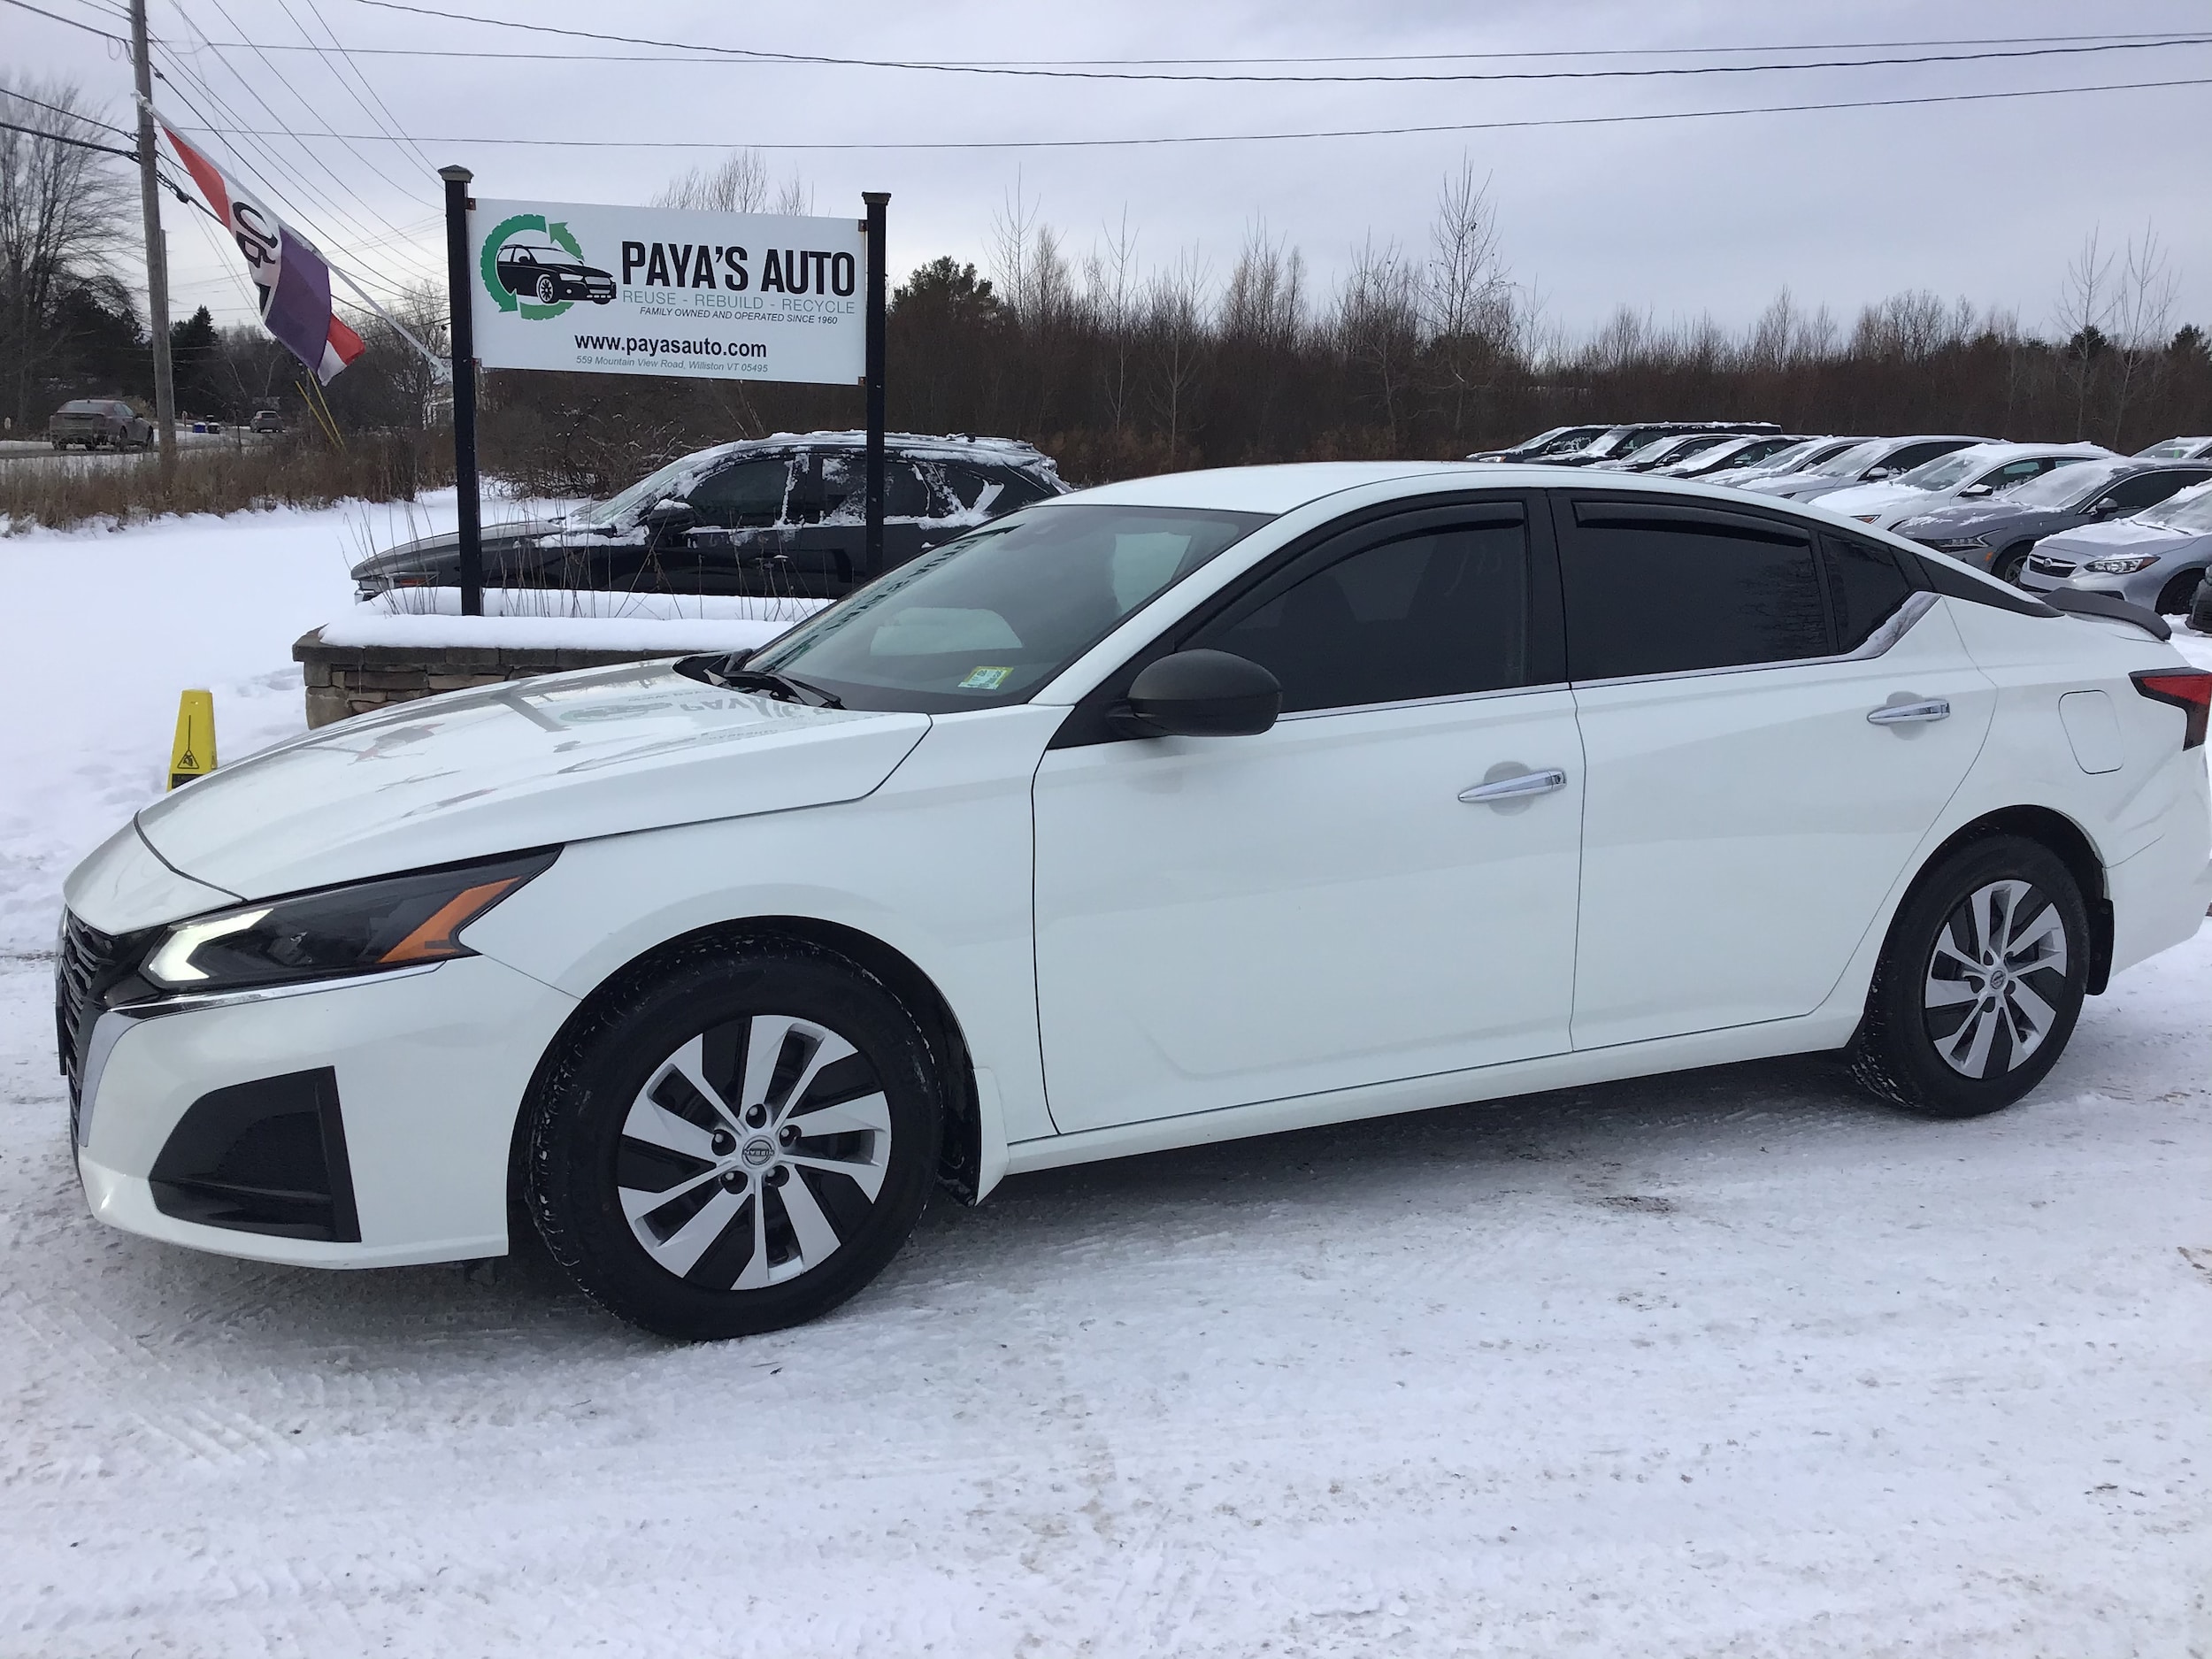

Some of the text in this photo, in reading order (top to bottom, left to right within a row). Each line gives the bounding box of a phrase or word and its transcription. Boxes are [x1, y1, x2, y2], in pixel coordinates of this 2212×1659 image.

[622, 241, 855, 296] PAYA'S AUTO
[622, 290, 676, 305] REUSE
[695, 294, 764, 310] REBUILD
[782, 298, 855, 314] RECYCLE
[640, 307, 838, 325] FAMILY OWNED AND OPERATED SINCE 1960
[574, 334, 767, 357] www.payasauto.com
[576, 355, 593, 365] 559
[595, 357, 635, 366] Mountain
[638, 358, 658, 368] View
[660, 359, 686, 370] Road,
[688, 360, 724, 371] Williston
[741, 364, 768, 373] 05495
